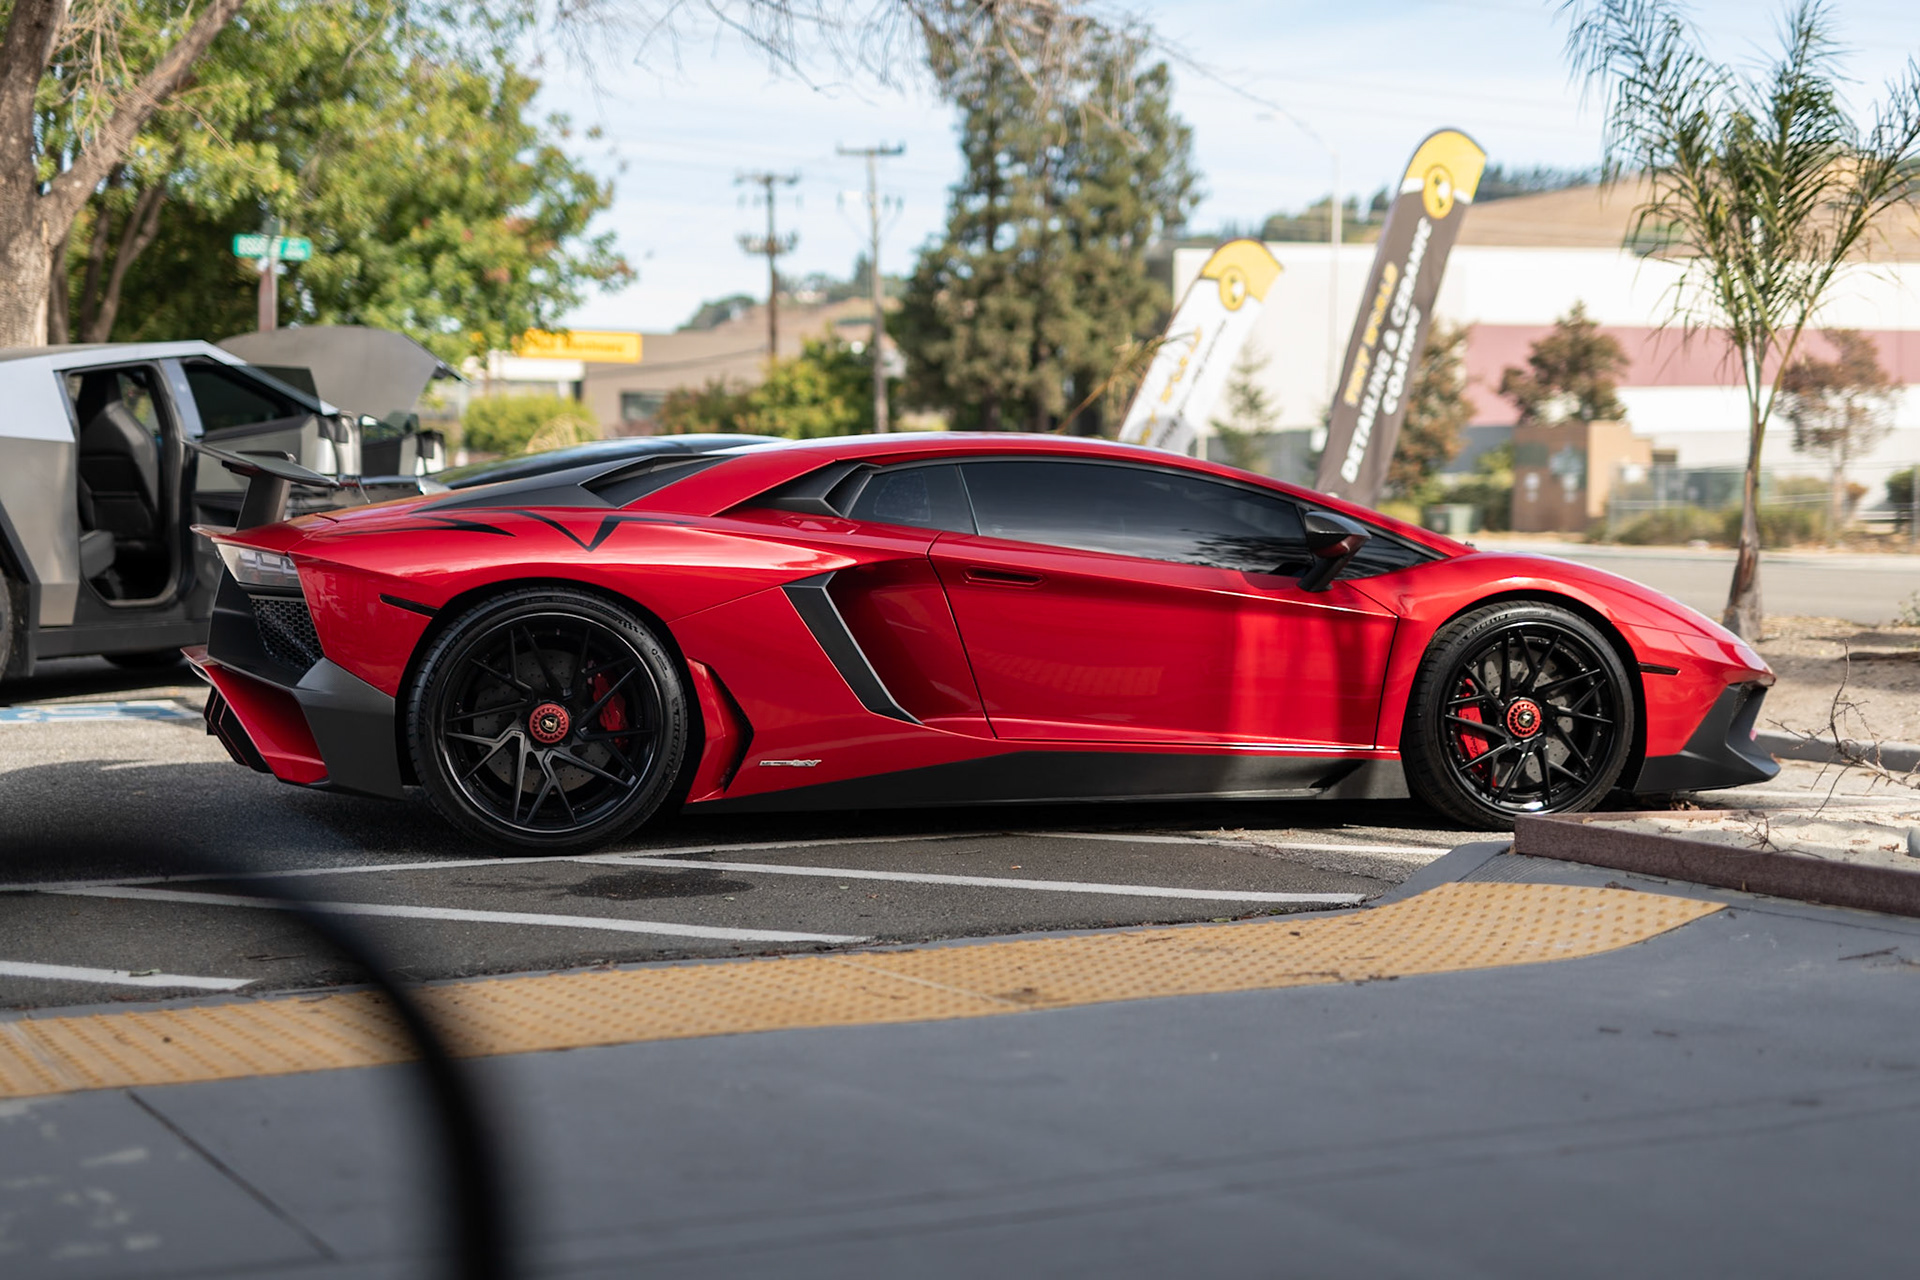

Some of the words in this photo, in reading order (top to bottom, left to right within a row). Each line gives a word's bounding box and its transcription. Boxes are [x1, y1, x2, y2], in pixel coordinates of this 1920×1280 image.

[1341, 349, 1392, 484] DETAILING
[1383, 329, 1399, 352] &
[1391, 216, 1432, 327] CERAMIC
[1465, 613, 1508, 637] MICHELIN
